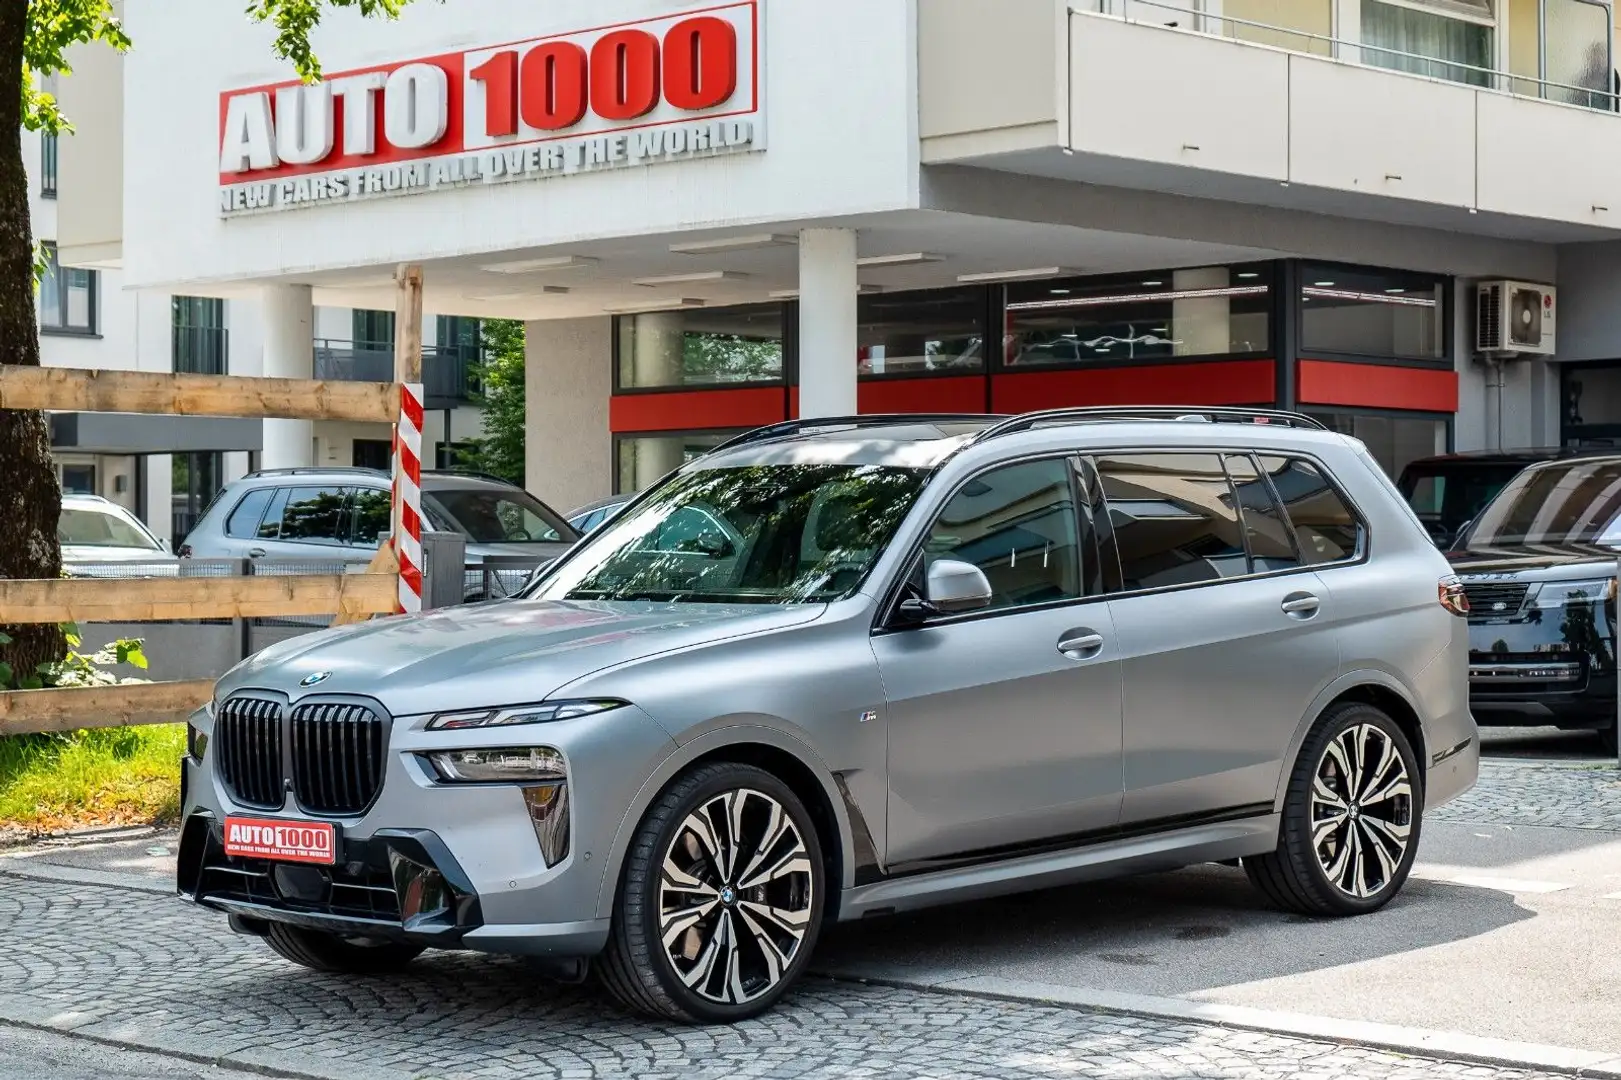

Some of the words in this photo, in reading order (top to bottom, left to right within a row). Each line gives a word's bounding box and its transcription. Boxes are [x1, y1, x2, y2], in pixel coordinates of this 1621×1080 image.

[220, 63, 448, 173] AUTO
[470, 16, 737, 137] 1000
[220, 184, 271, 212] NEW
[275, 174, 348, 204] CARS
[350, 162, 431, 195] FROM
[430, 156, 483, 187] ALL
[483, 147, 563, 178] OVER
[563, 136, 628, 169] THE
[629, 121, 752, 161] WORLD
[229, 824, 274, 845] AUTO
[278, 828, 327, 849] 1000
